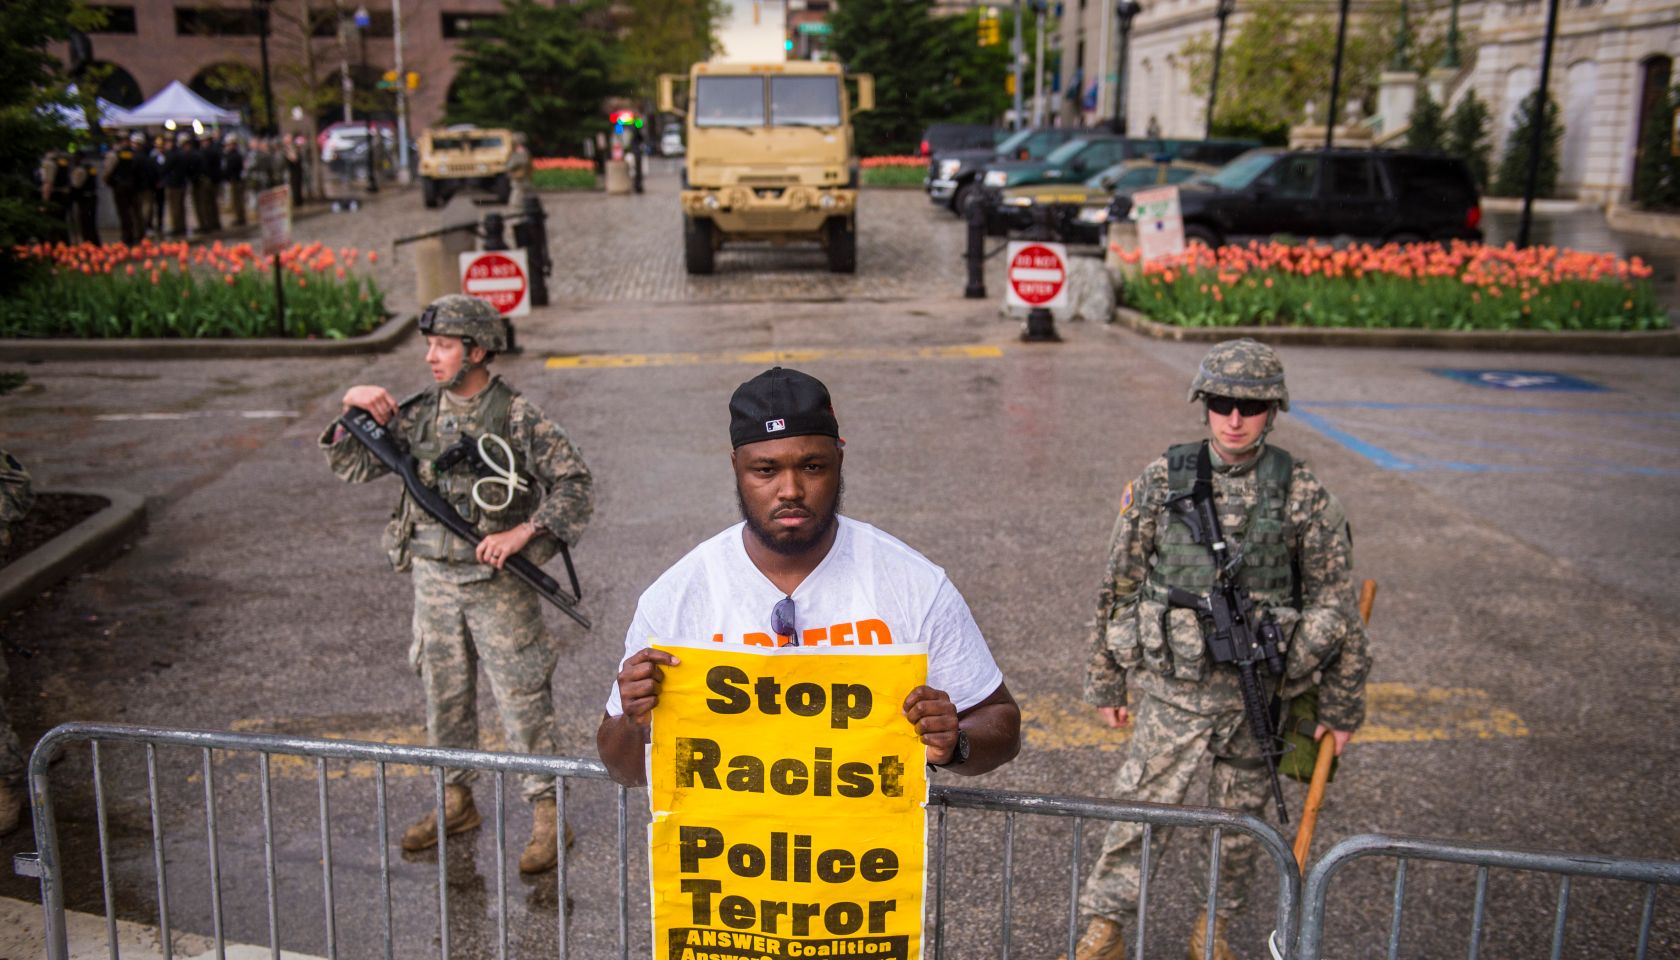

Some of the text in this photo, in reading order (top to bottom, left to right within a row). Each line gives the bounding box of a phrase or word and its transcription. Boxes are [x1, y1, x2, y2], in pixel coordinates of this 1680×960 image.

[471, 264, 489, 277] DO
[1016, 254, 1057, 267] DO NOT
[1018, 282, 1053, 296] ENTER
[1169, 453, 1200, 472] US
[706, 665, 872, 729] Stop
[675, 737, 904, 798] Racist
[679, 826, 899, 883] Police
[680, 879, 896, 936] Terror
[686, 929, 892, 957] ANSWER Coalition
